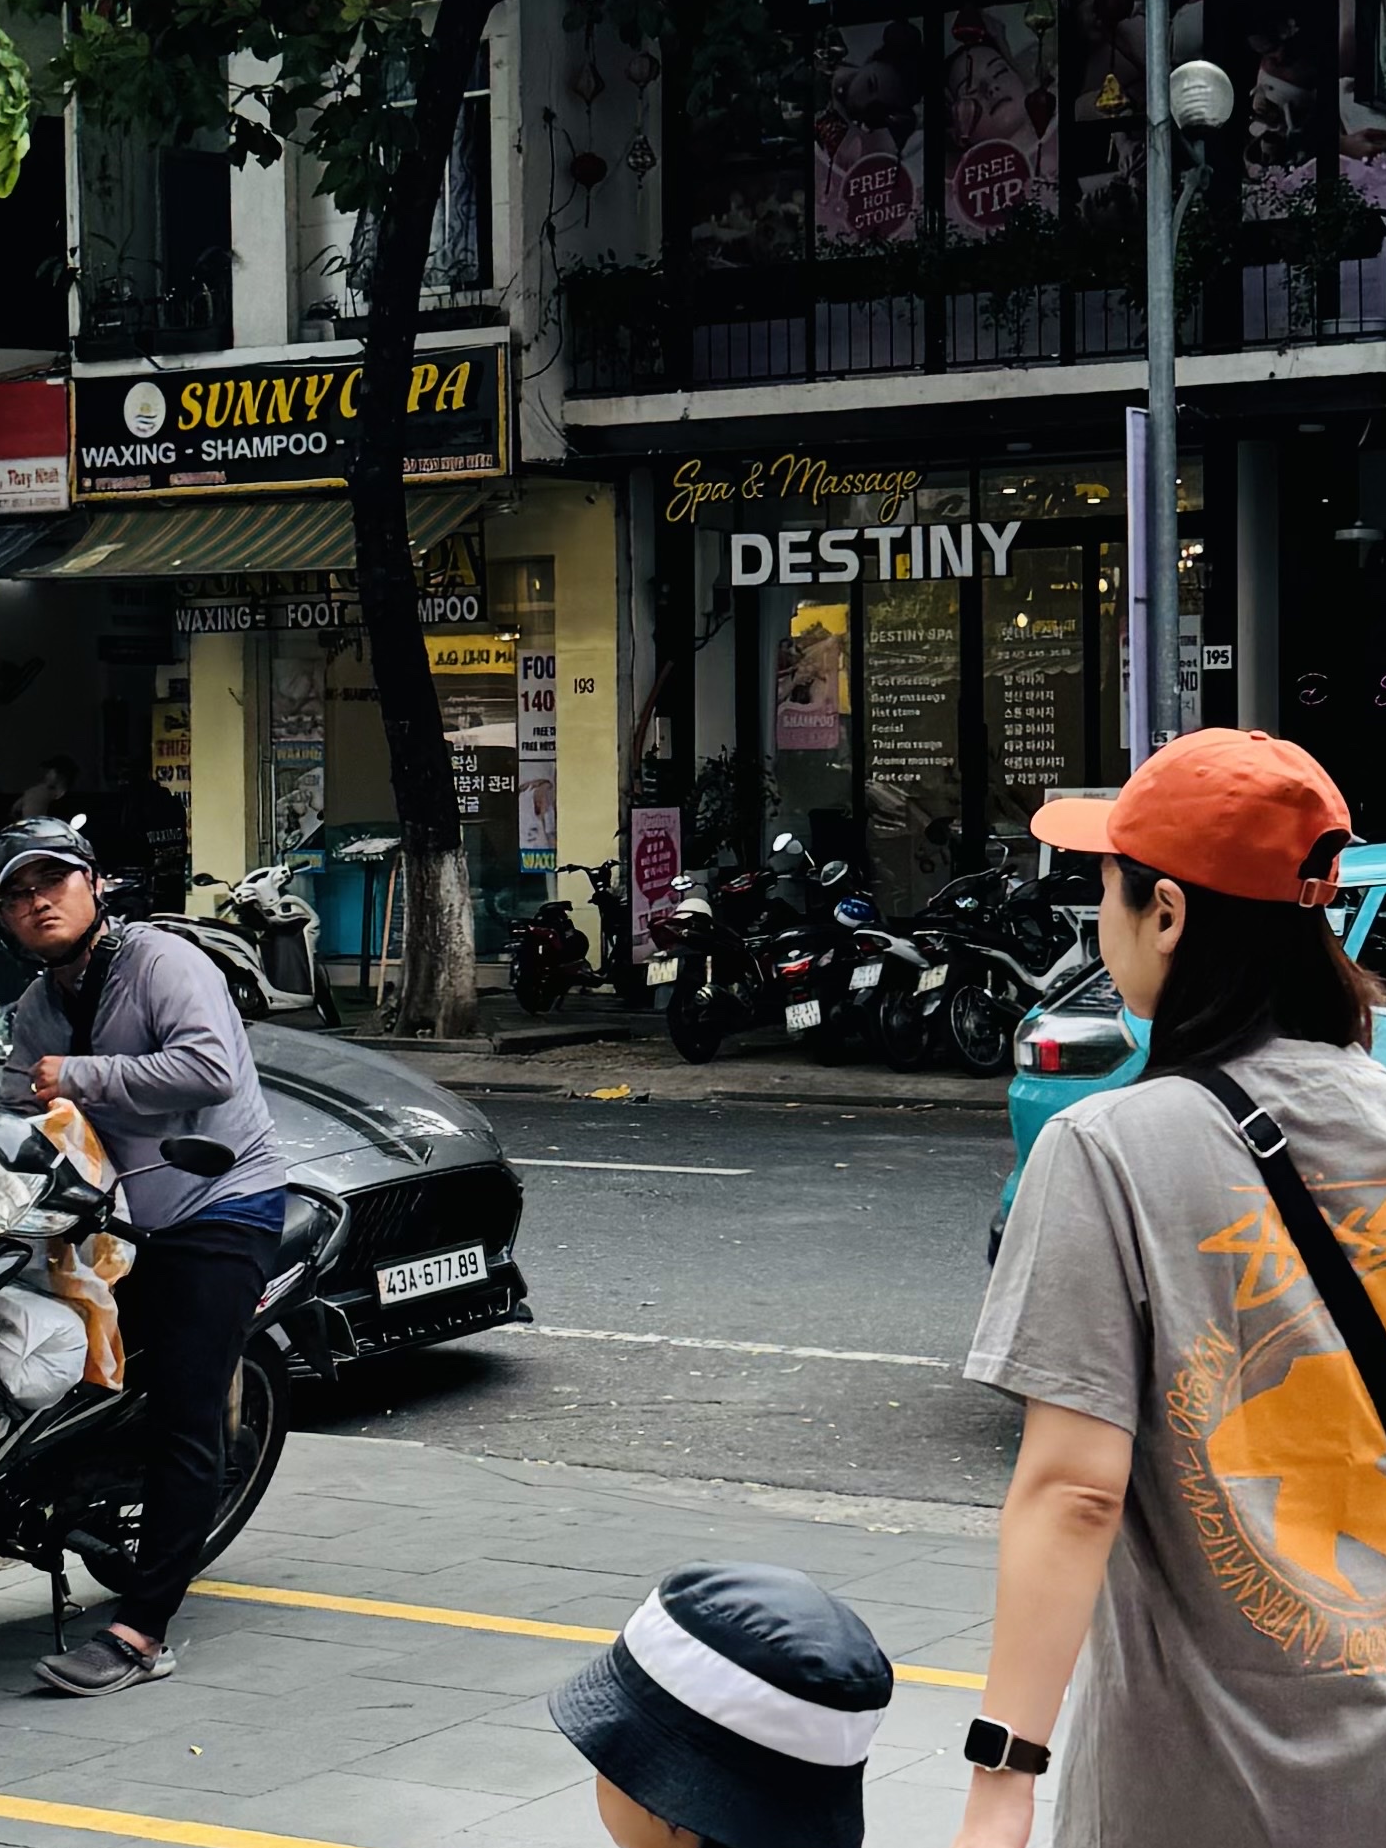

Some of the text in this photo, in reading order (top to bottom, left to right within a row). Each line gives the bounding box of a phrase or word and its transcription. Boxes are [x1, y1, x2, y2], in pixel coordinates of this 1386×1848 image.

[962, 153, 1016, 185] FREE
[849, 166, 898, 197] FREE
[862, 190, 892, 210] HOT
[968, 177, 1023, 218] TIP
[855, 203, 909, 230] STONE
[178, 373, 335, 432] SUNNY
[82, 432, 328, 469] WAXING SHAMPOO
[666, 454, 925, 524] Spa & Massage
[731, 520, 1022, 587] DESTINY
[176, 606, 251, 631] WAXING
[287, 601, 342, 627] FOOT
[869, 628, 954, 643] DESTINY SPA
[1205, 649, 1230, 665] 195
[574, 677, 595, 694] 193
[899, 694, 946, 704] massage
[871, 707, 921, 718] Hot stone
[871, 724, 904, 735] Facial
[872, 739, 943, 752] Thai massage
[908, 756, 955, 768] massage
[453, 775, 516, 794] 꿈치 관리
